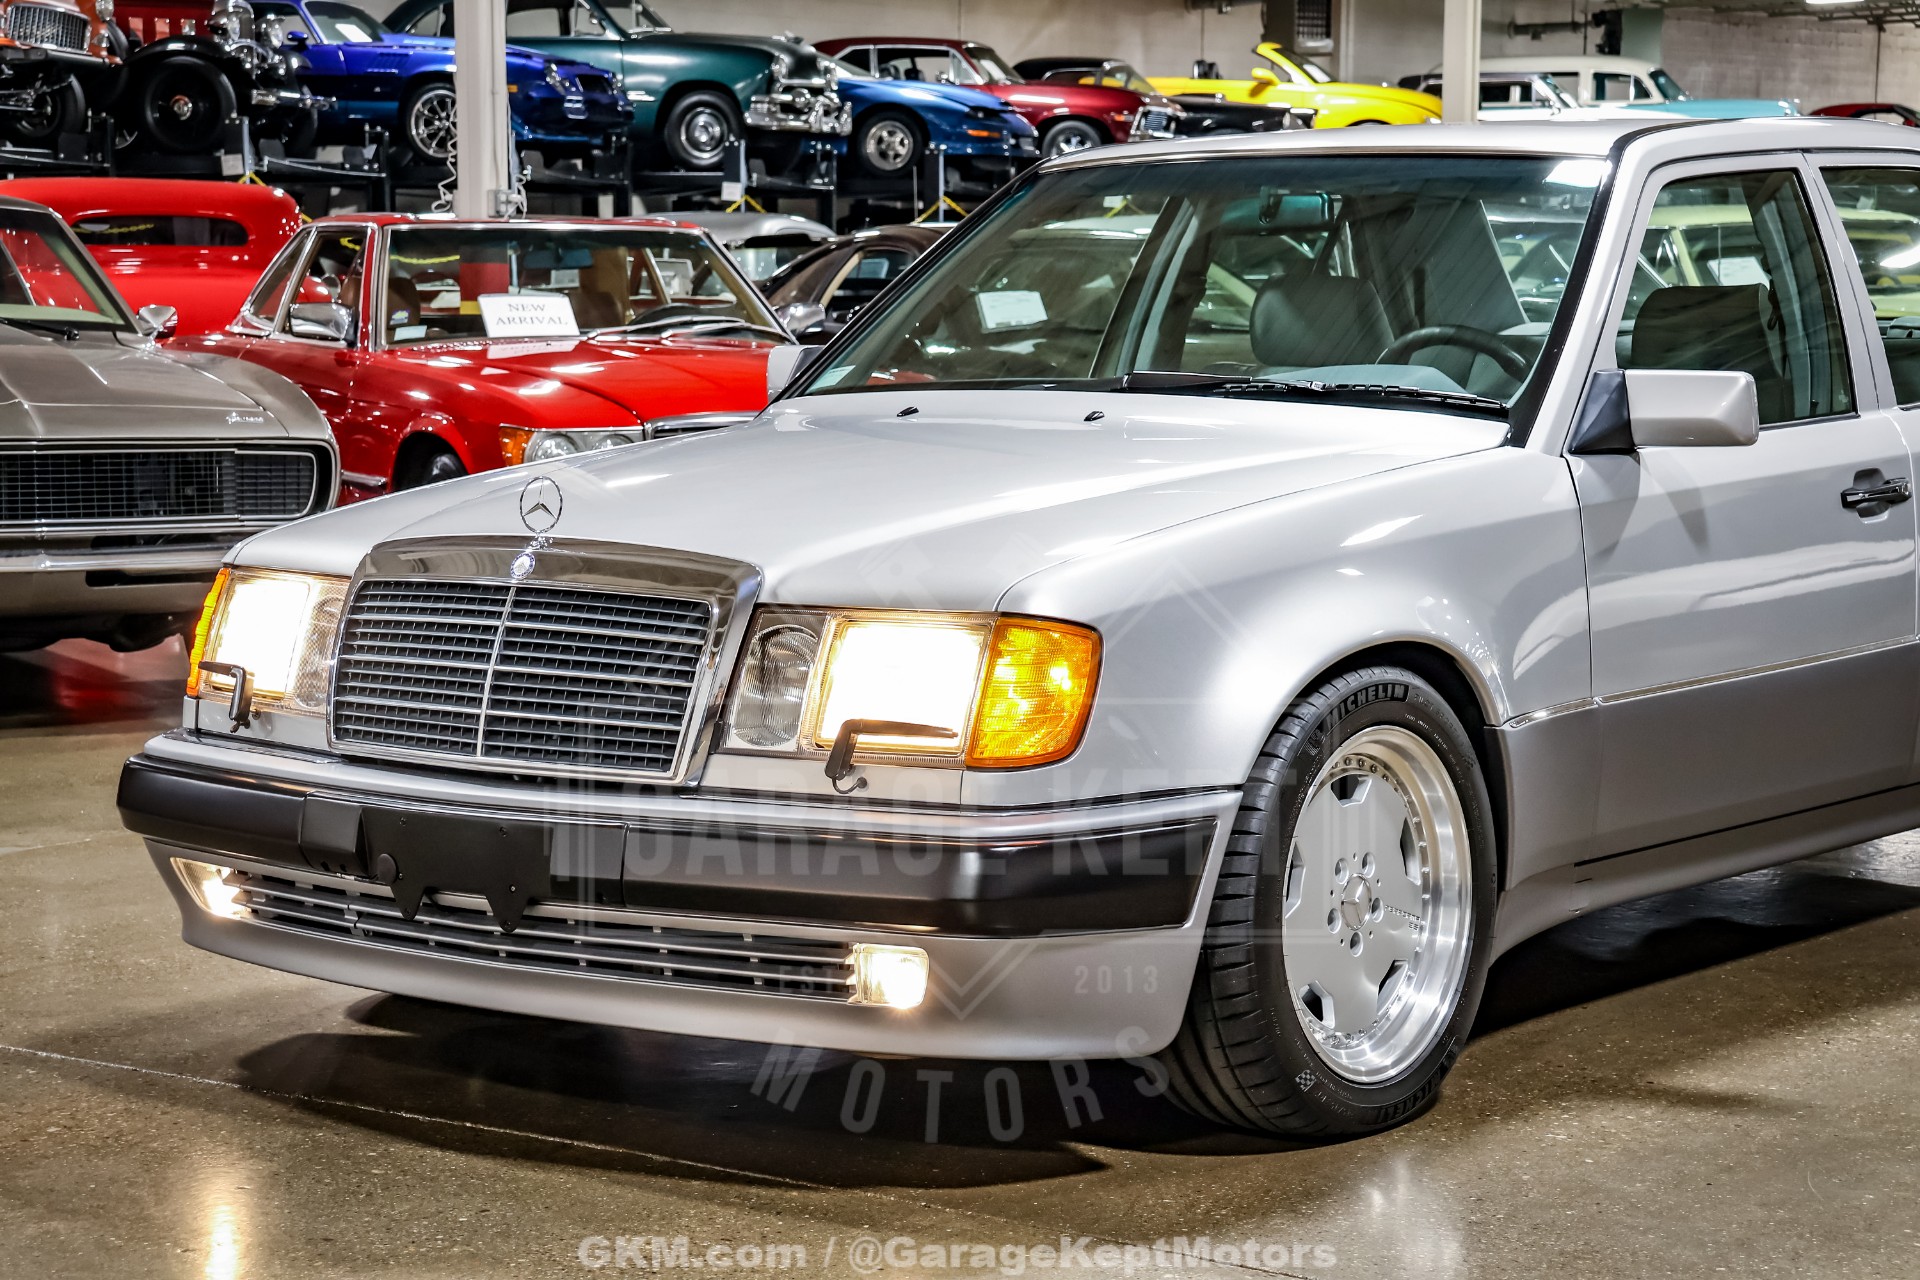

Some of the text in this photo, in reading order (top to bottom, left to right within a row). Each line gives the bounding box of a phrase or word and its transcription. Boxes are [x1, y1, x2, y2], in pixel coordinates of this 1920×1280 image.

[508, 303, 546, 312] NEW
[496, 316, 569, 326] ARRIVAL
[1325, 683, 1405, 731] MICHELIN
